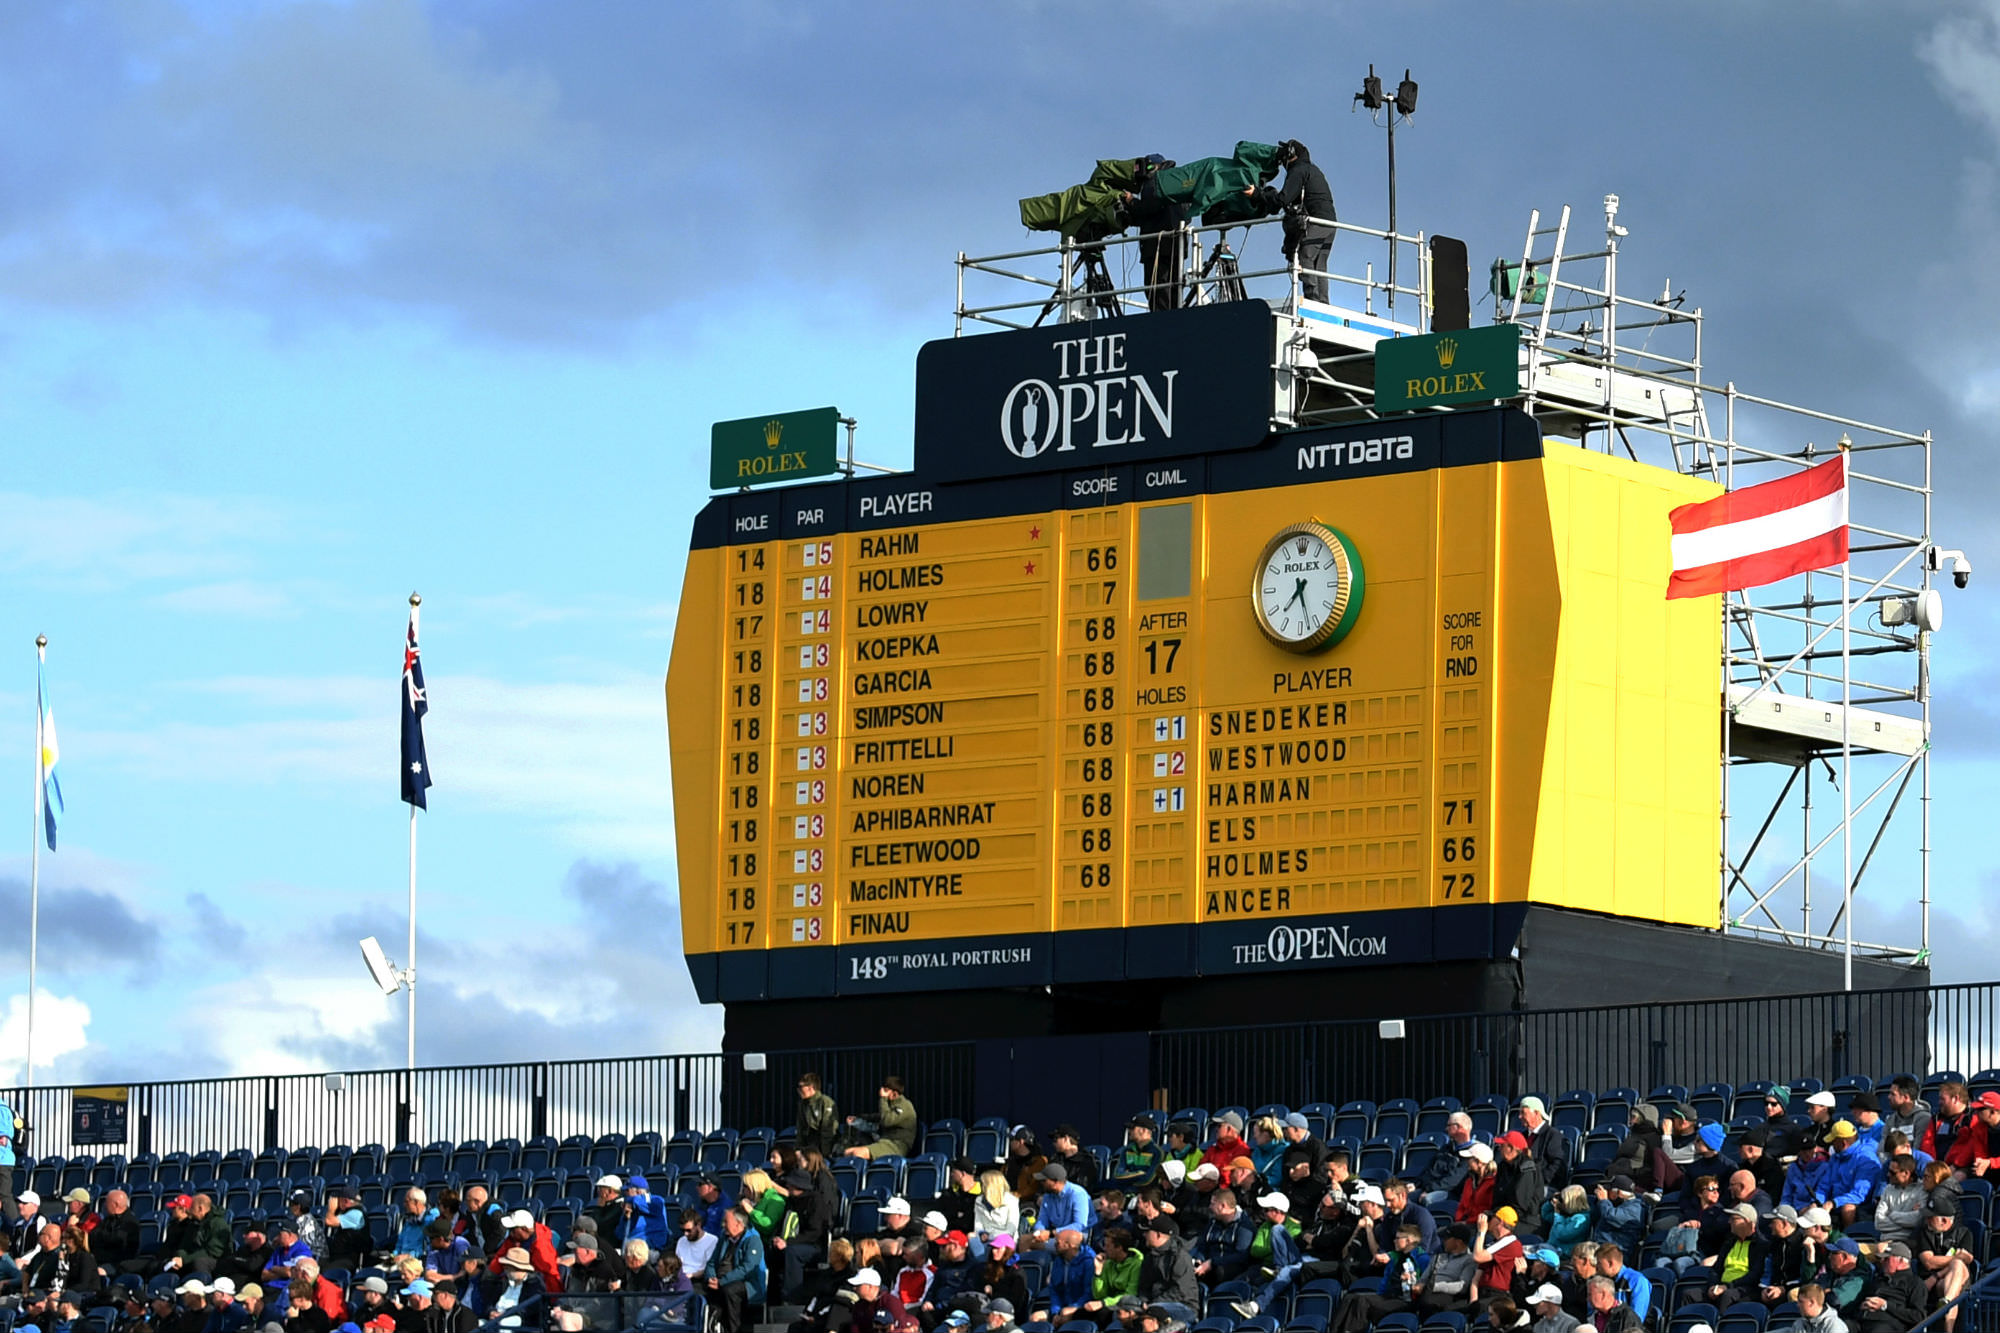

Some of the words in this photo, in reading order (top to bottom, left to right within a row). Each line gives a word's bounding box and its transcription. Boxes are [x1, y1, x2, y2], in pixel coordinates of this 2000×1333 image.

[1053, 332, 1127, 380] THE
[1406, 371, 1486, 399] ROLEX
[1000, 370, 1178, 459] OPEN
[737, 451, 808, 477] ROLEX
[1297, 442, 1346, 470] NTT
[736, 515, 769, 533] HOLE
[797, 508, 824, 526] PAR
[860, 491, 933, 518] PLAYER
[1072, 477, 1119, 496] SCORE
[738, 549, 765, 572] 14
[860, 533, 919, 559] RAHM
[1283, 560, 1320, 574] ROLEX
[737, 582, 764, 606] 18
[858, 564, 944, 593] HOLMES
[1087, 547, 1117, 571] 66
[736, 616, 763, 640] 17
[857, 601, 929, 628] LOWRY
[1103, 581, 1117, 604] 7
[1138, 611, 1188, 631] AFTER
[1443, 611, 1481, 630] SCORE
[735, 650, 762, 674] 18
[857, 634, 941, 662] KOEPKA
[1086, 617, 1116, 642] 68
[1144, 639, 1181, 675] 17
[1451, 634, 1474, 651] FOR
[735, 684, 761, 707] 18
[854, 669, 933, 696] GARCIA
[1085, 652, 1115, 677] 68
[1273, 667, 1352, 694] PLAYER
[1446, 656, 1478, 678] RND
[733, 718, 760, 741] 18
[855, 702, 944, 730] SIMPSON
[1084, 687, 1114, 711] 68
[1137, 686, 1186, 706] HOLES
[1210, 702, 1348, 737] SNEDEKER
[732, 752, 759, 775] 18
[854, 735, 954, 765] FRITTELLI
[1083, 722, 1113, 747] 68
[1209, 738, 1347, 772] WESTWOOD
[731, 786, 758, 809] 18
[852, 773, 925, 799] NOREN
[1083, 757, 1113, 782] 68
[1208, 776, 1310, 807] HARMAN
[730, 820, 757, 843] 18
[853, 803, 996, 833] APHIBARNRAT
[1082, 792, 1112, 818] 68
[1208, 818, 1256, 844] ELS
[1444, 800, 1475, 825] 71
[729, 853, 756, 877] 18
[851, 838, 981, 868] FLEETWOOD
[1081, 828, 1111, 853] 68
[1207, 849, 1309, 878] HOLMES
[1442, 837, 1476, 863] 66
[729, 887, 755, 911] 18
[850, 874, 963, 903] MacINTYRE
[1081, 863, 1111, 888] 68
[1206, 888, 1291, 915] ANCER
[1442, 873, 1476, 899] 72
[728, 921, 755, 944] 17
[850, 911, 910, 936] FINAU
[902, 952, 949, 969] ROYAL
[951, 947, 1032, 966] PORTRUSH
